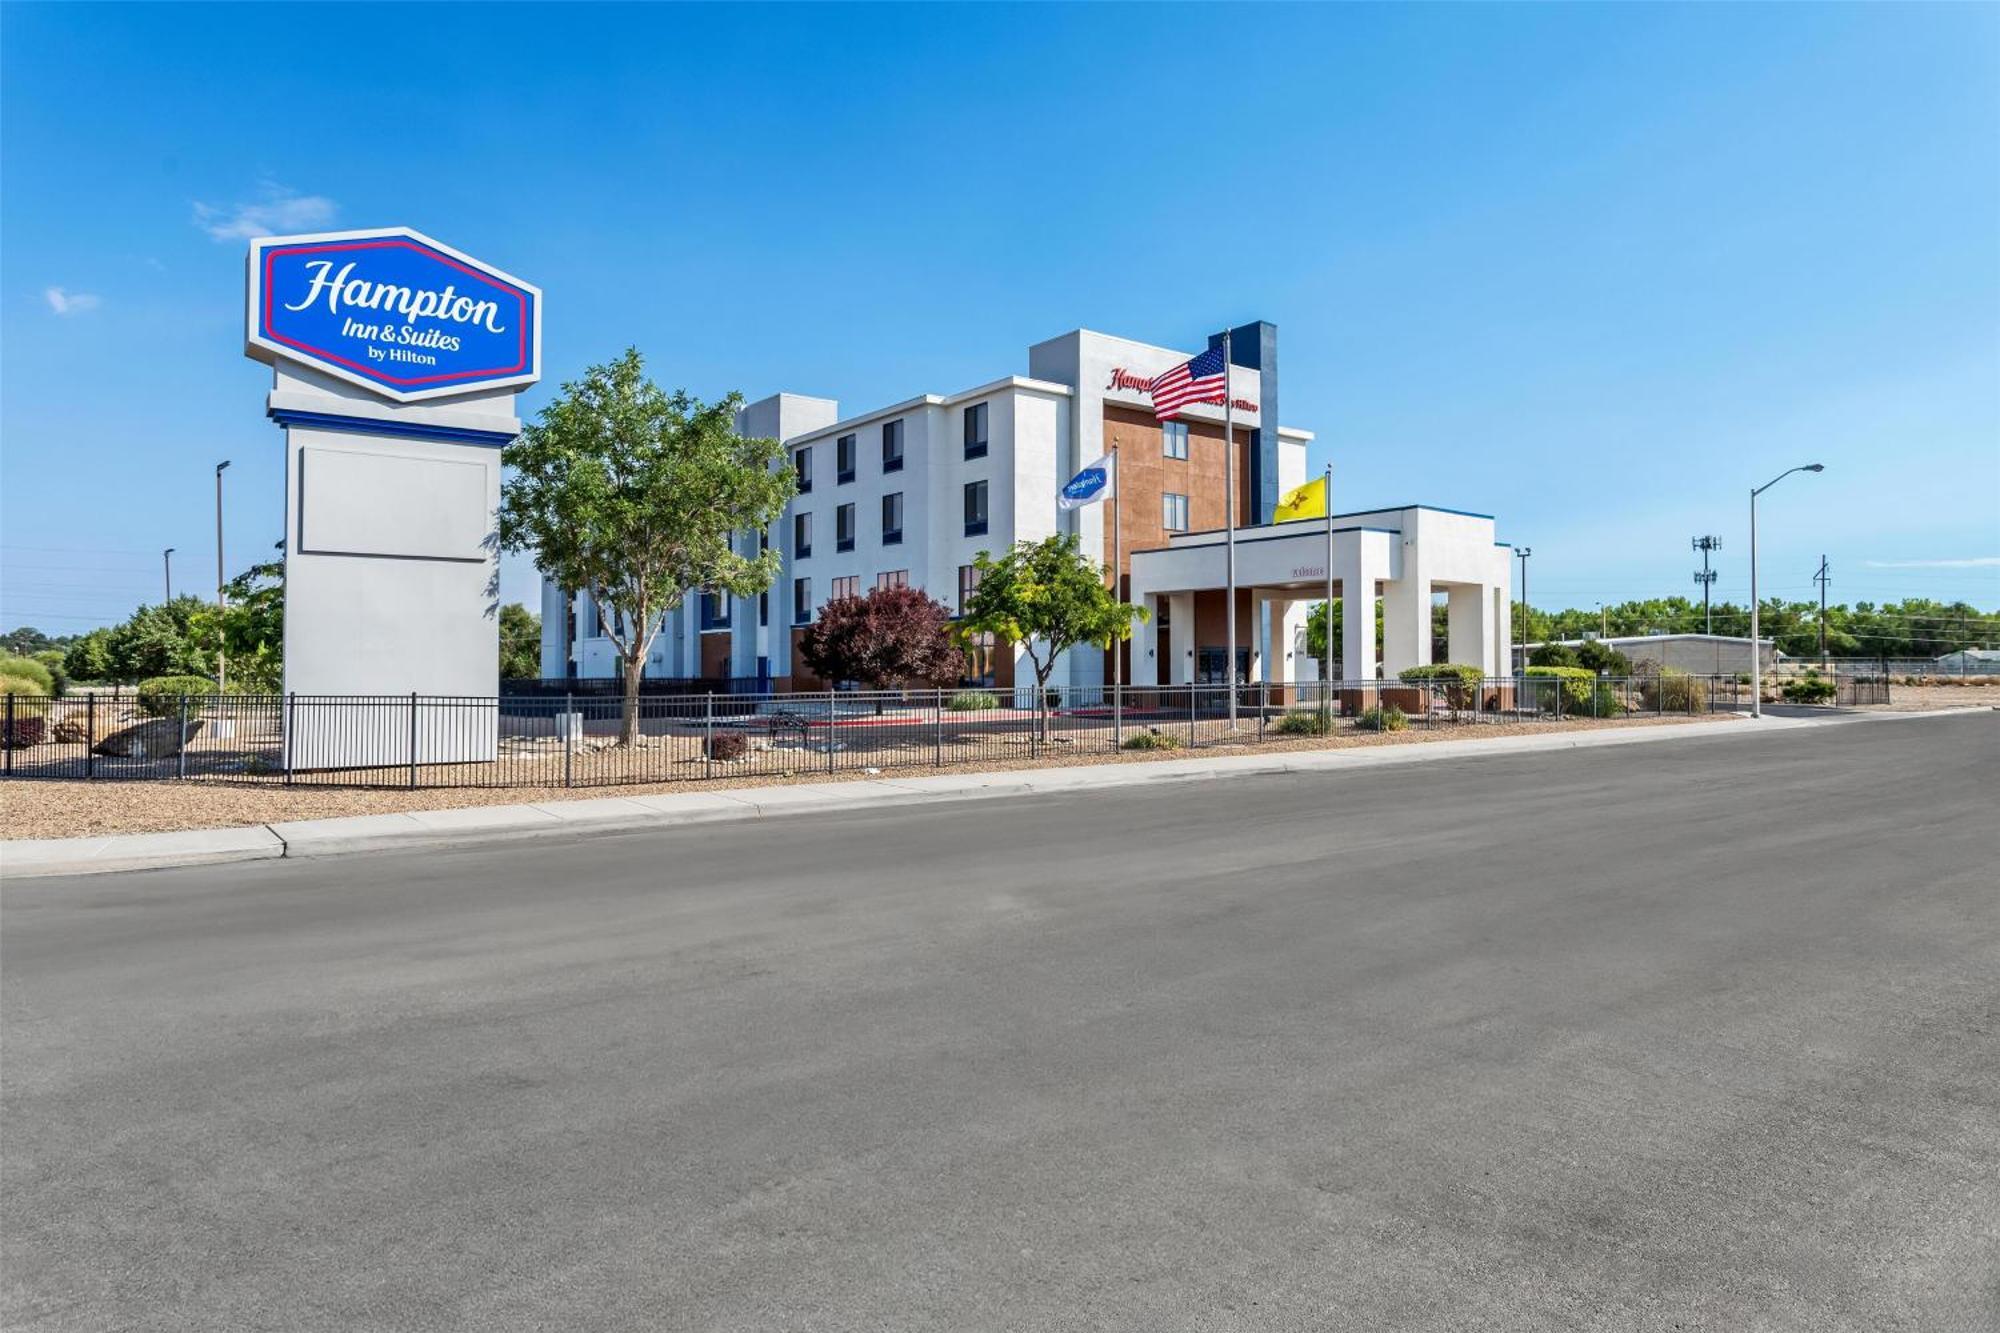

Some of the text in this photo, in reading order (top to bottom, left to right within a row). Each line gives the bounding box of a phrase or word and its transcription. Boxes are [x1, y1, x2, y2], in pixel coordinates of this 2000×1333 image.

[285, 261, 505, 333] Hampton
[369, 346, 436, 365] by Hilton
